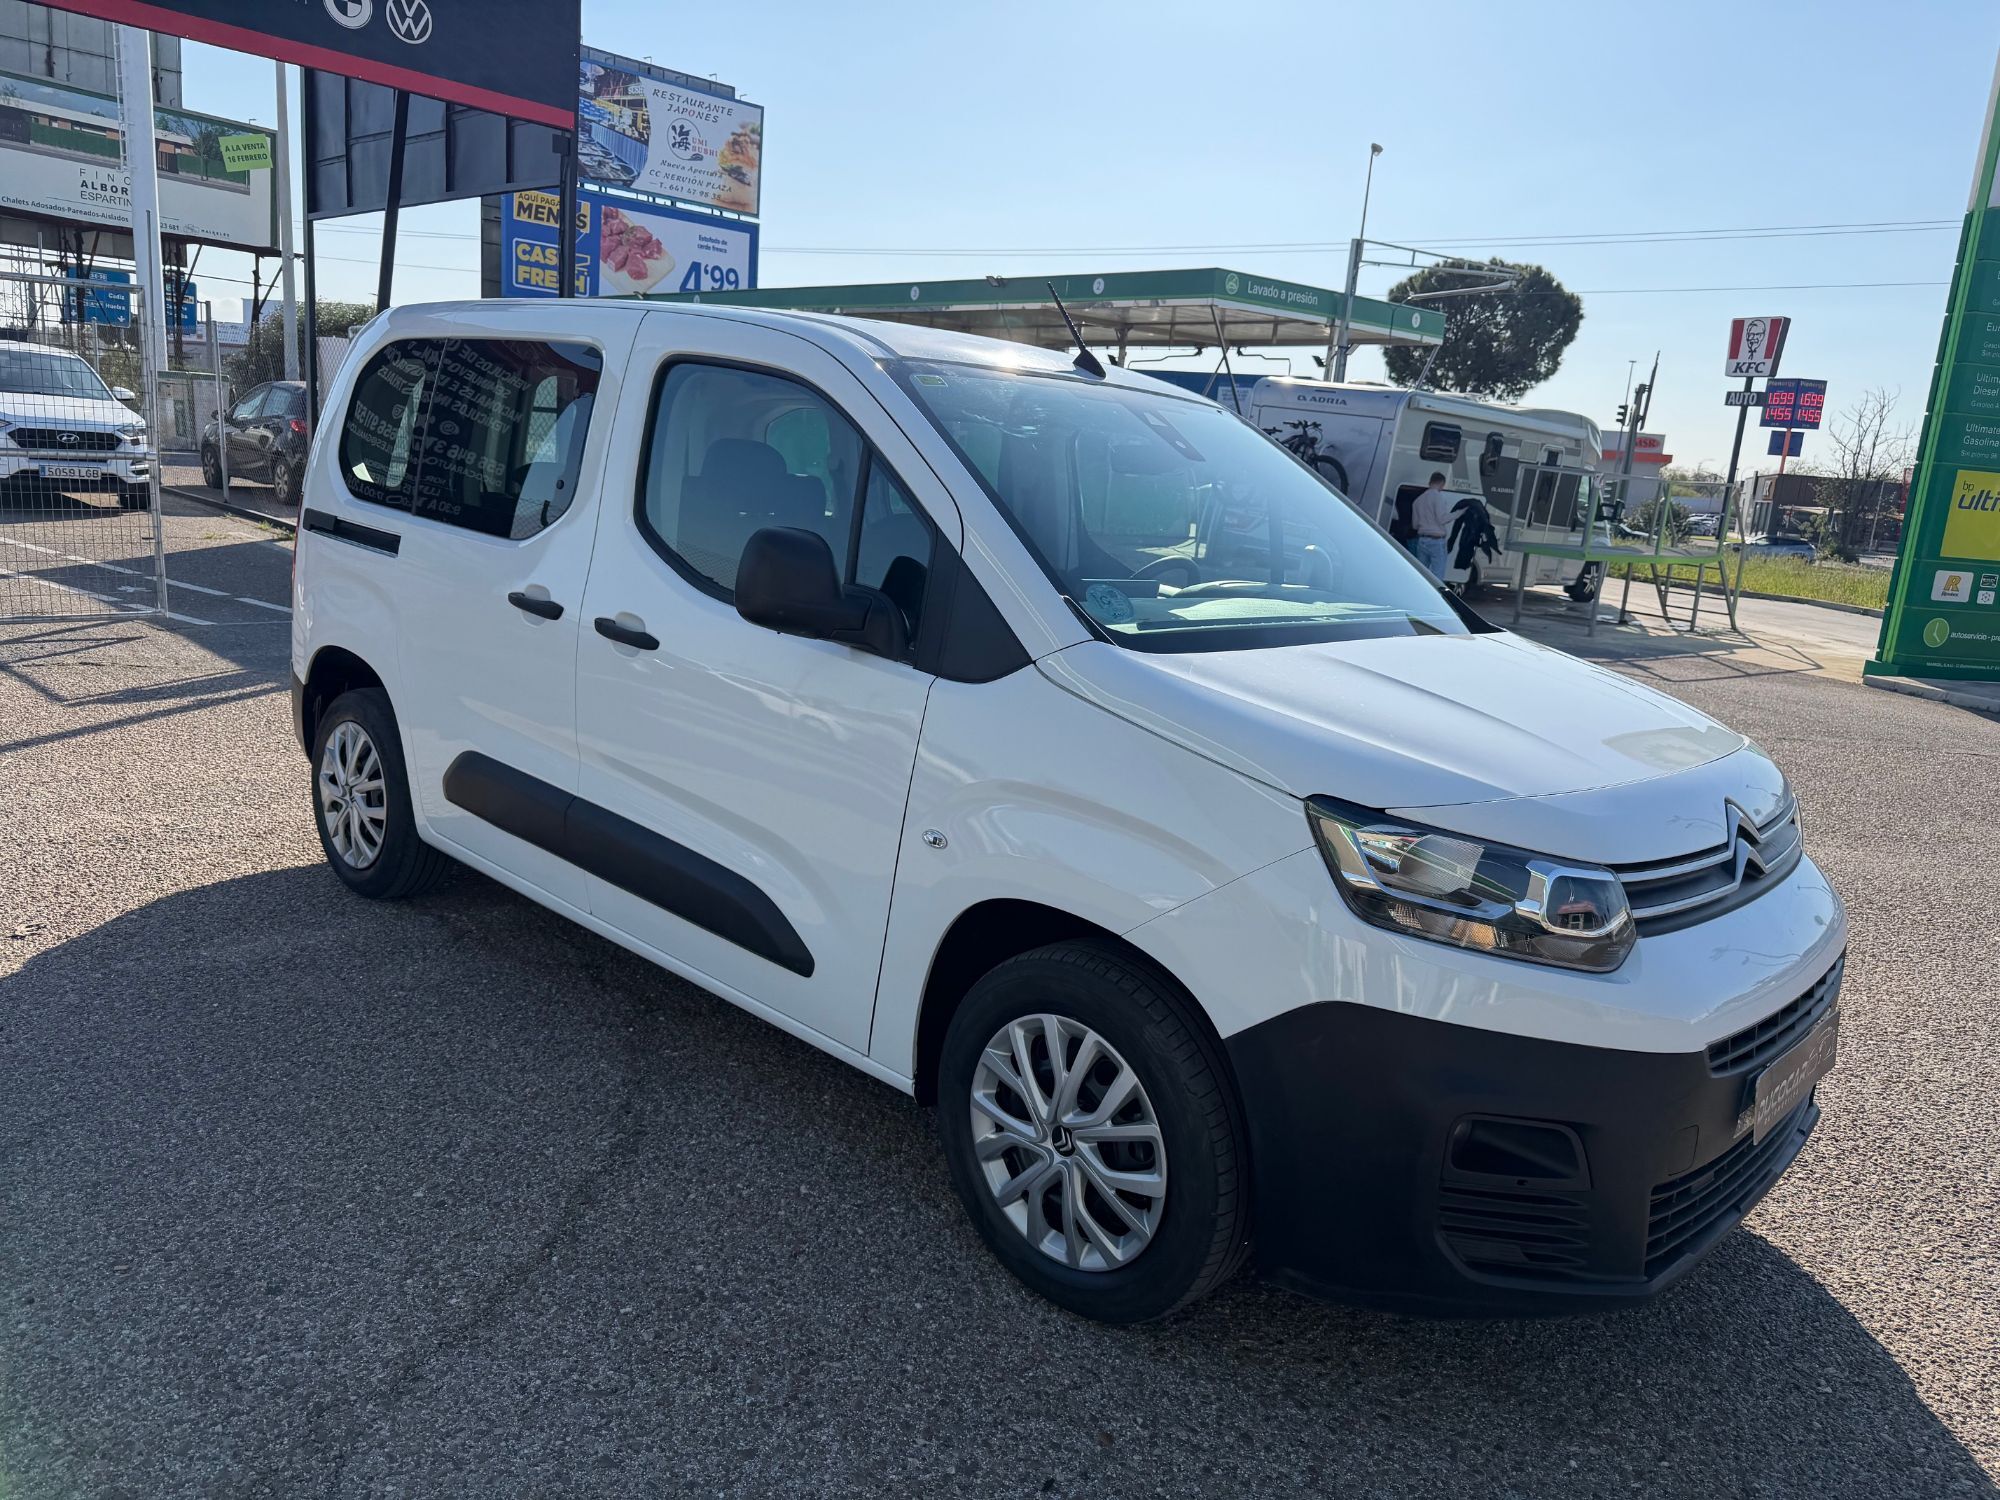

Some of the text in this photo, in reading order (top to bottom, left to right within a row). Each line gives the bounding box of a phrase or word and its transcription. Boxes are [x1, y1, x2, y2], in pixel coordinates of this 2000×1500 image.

[652, 88, 734, 116] RESTAURANTE
[667, 103, 719, 123] JAPONES
[237, 153, 268, 162] FEBRERO
[660, 160, 686, 171] Nueva
[649, 169, 661, 177] CC
[706, 182, 732, 193] PLAZA
[2, 195, 30, 206] Chalets
[518, 193, 538, 202] AQUÍ
[516, 201, 588, 230] MENS
[516, 243, 559, 266] CAS
[517, 264, 586, 293] FREH
[1247, 281, 1279, 299] Lavado
[1287, 291, 1319, 305] presión
[1732, 361, 1766, 374] KFC
[1973, 385, 2000, 396] Diesel
[1309, 396, 1348, 406] ADRIA
[1727, 392, 1758, 405] AUTO
[1768, 392, 1795, 405] 1.699
[1765, 407, 1793, 421] 1.455
[1963, 435, 2000, 447] Gasolina
[48, 467, 99, 478] 5059 LGB
[1962, 480, 1975, 492] bp
[1950, 629, 1987, 641] autoservicio
